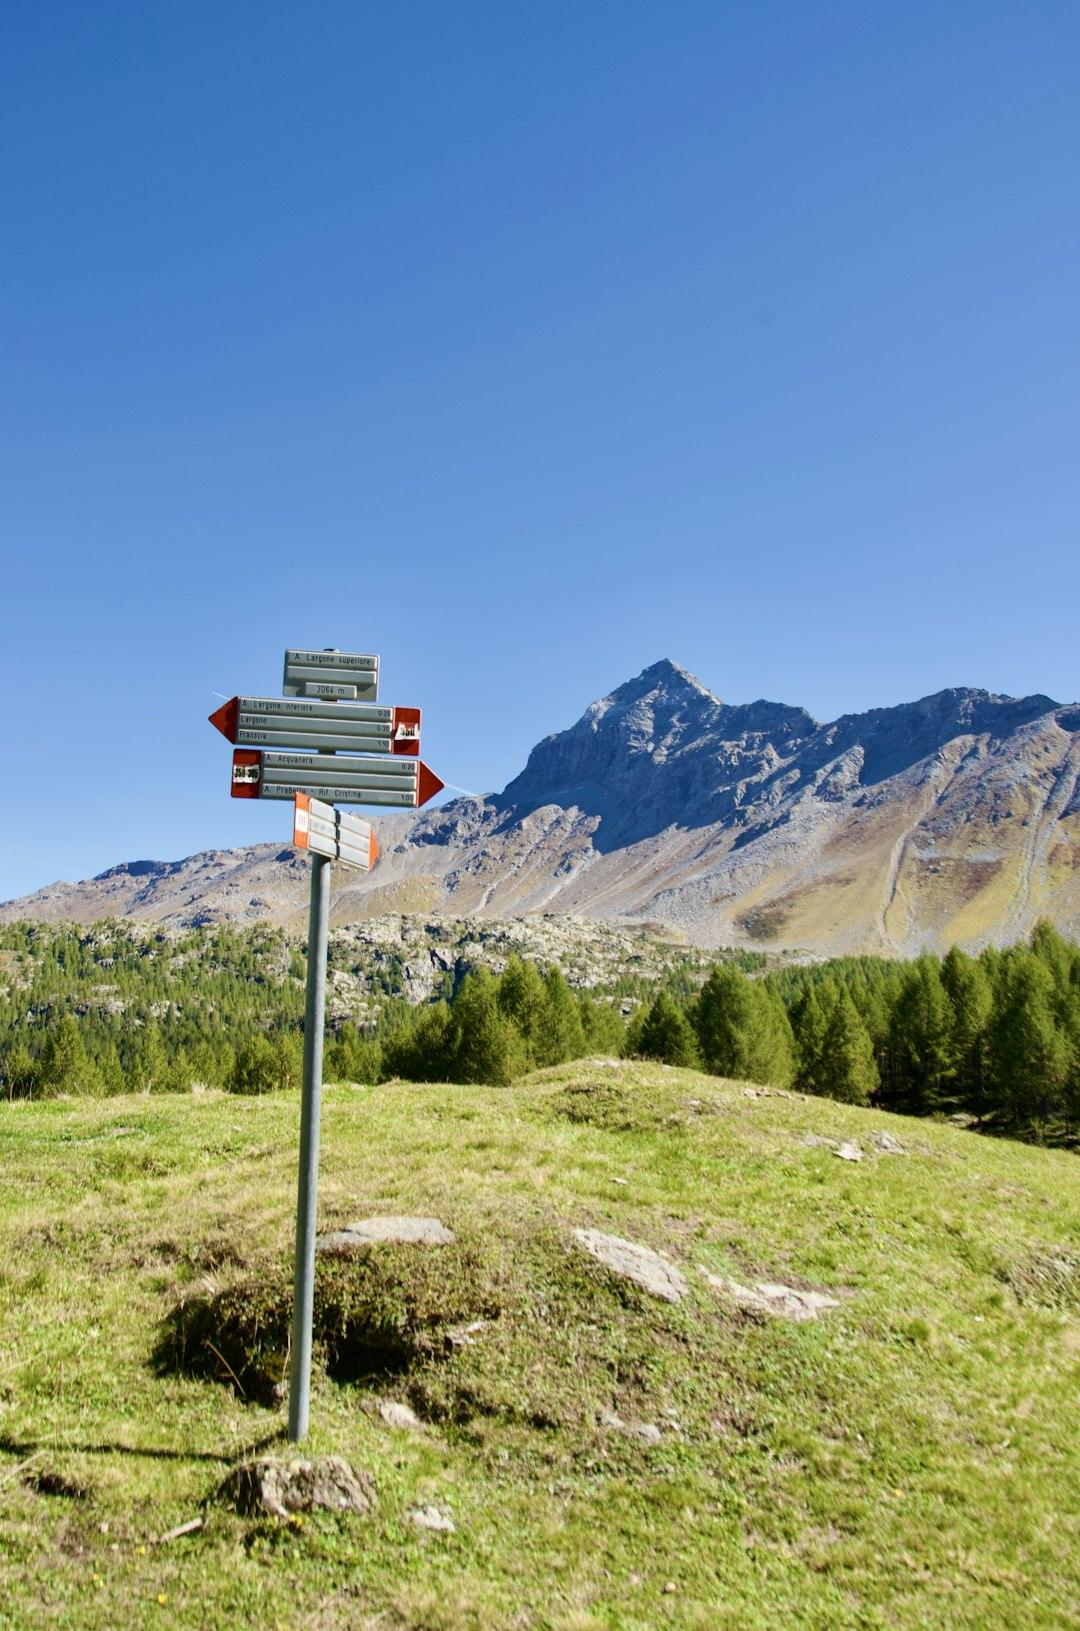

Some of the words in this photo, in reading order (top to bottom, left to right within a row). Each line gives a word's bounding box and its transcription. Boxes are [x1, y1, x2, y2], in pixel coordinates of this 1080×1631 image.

[306, 653, 335, 663] Largone
[338, 656, 371, 666] superiore
[317, 685, 334, 694] 2064
[253, 701, 281, 710] Largone
[284, 702, 313, 712] inferiore
[240, 715, 267, 724] Largone
[239, 730, 267, 740] Franscia
[277, 754, 313, 764] Acquanera
[334, 789, 361, 798] Cristina
